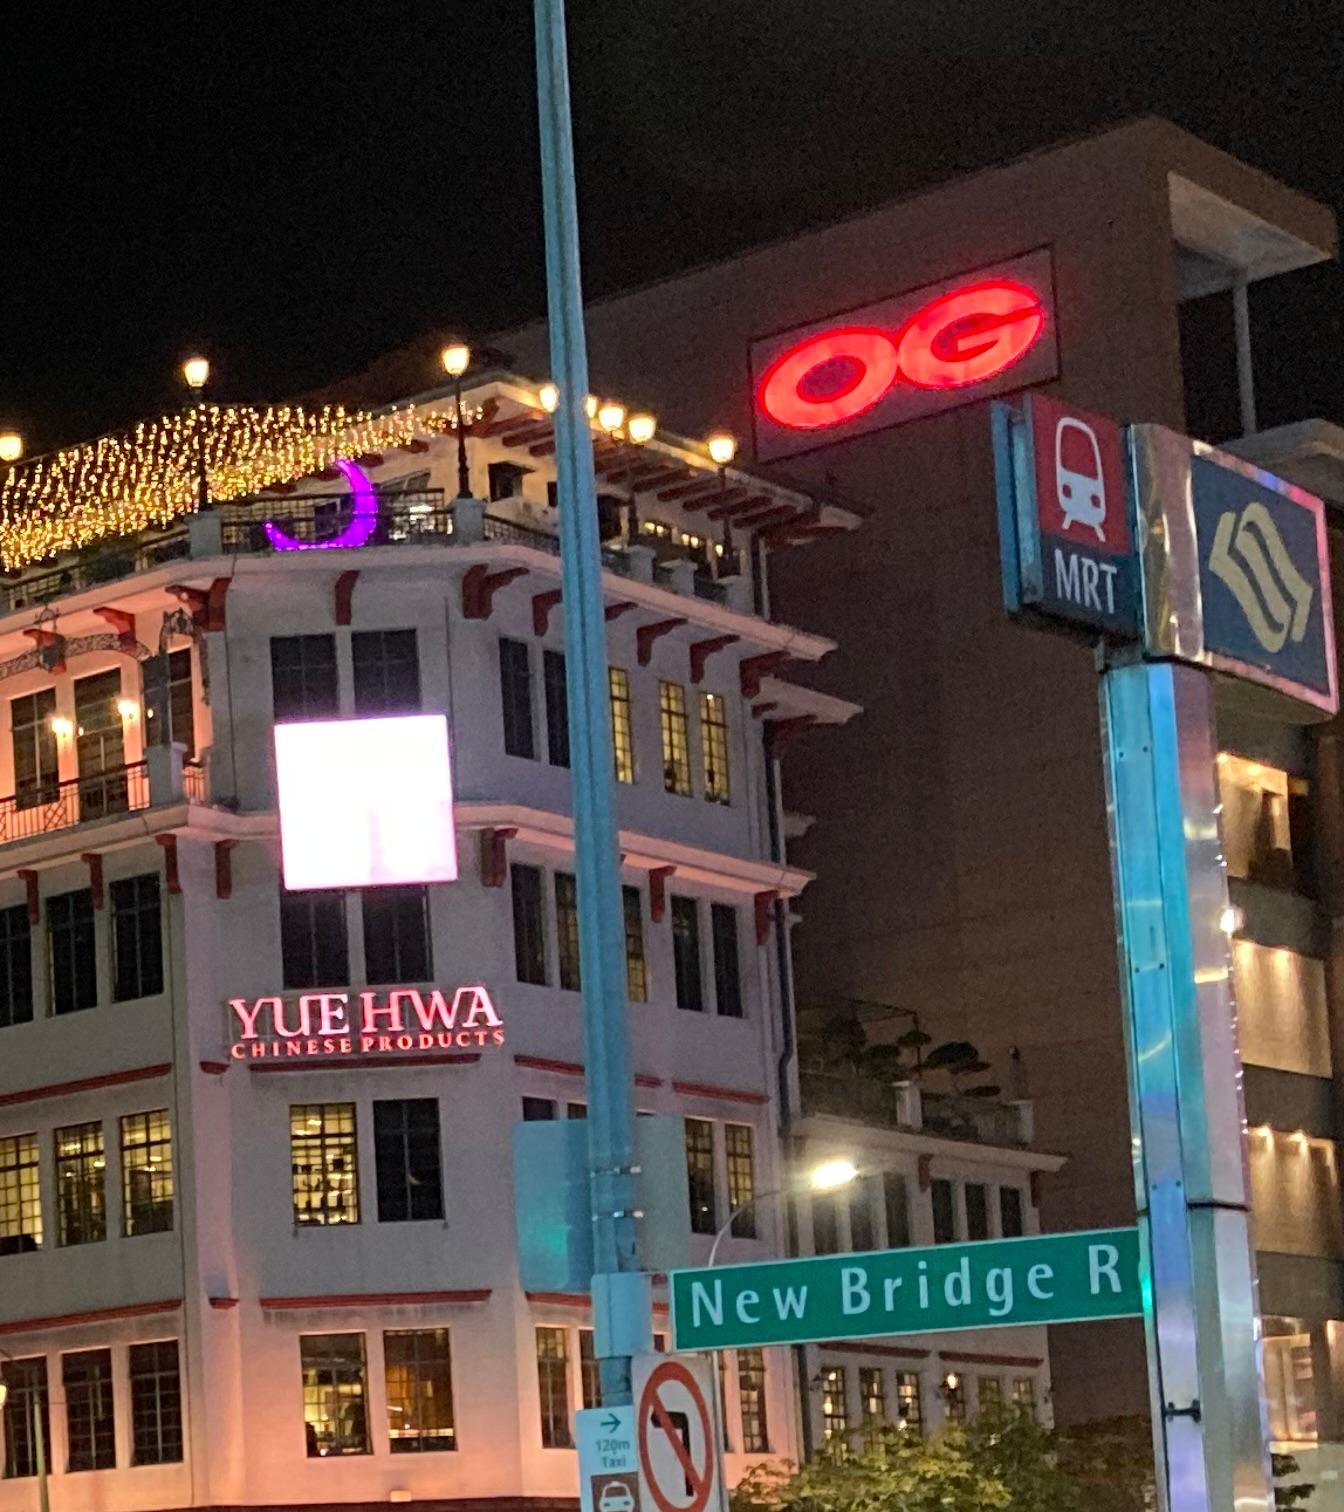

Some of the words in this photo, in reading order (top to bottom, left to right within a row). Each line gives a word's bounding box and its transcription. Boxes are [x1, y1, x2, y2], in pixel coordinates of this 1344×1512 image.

[759, 279, 1044, 430] OG
[1054, 548, 1118, 614] MRT
[227, 993, 350, 1039] YUE
[360, 985, 504, 1033] HWA
[231, 1037, 352, 1059] CHINESE
[362, 1029, 505, 1053] PRODUCTS
[691, 1279, 808, 1327] New
[840, 1257, 1054, 1317] Bridge
[595, 1439, 631, 1452] 120m
[601, 1455, 627, 1468] Taxi
